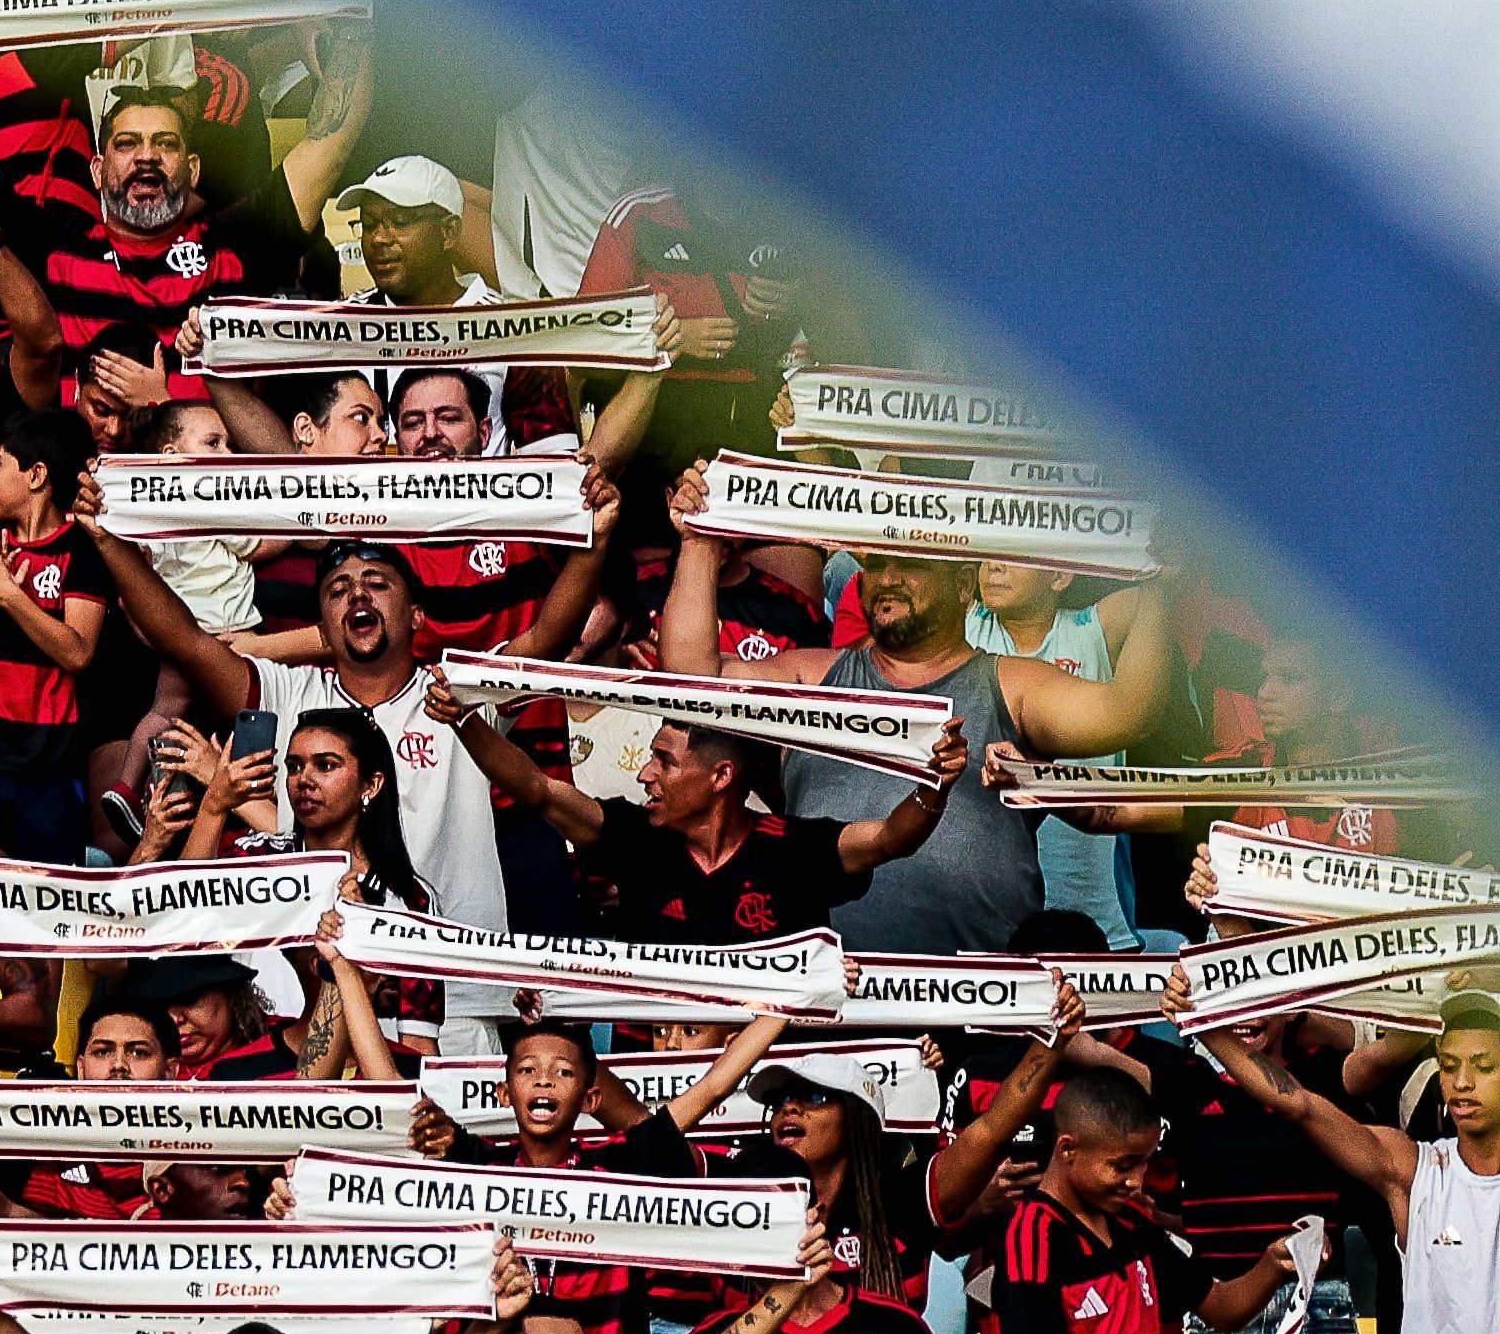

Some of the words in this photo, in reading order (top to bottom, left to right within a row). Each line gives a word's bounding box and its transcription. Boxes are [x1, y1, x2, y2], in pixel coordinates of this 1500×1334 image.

[727, 475, 778, 506] PRA
[788, 483, 862, 513] CIMA
[871, 491, 955, 524] DELES,
[325, 513, 387, 525] Betano
[909, 530, 969, 546] Betano
[10, 1105, 92, 1126] CIMA
[99, 1105, 192, 1132] DELES,
[200, 1106, 383, 1130] FLAMENGO!
[328, 1173, 384, 1204] PRA
[395, 1179, 474, 1211] CIMA
[485, 1186, 575, 1224] DELES,
[587, 1193, 770, 1230] FLAMENGO!
[530, 1227, 595, 1243] Betano
[13, 1243, 68, 1270] PRA
[79, 1243, 159, 1270] CIMA
[170, 1244, 261, 1272] DELES,
[273, 1244, 456, 1270] FLAMENGO!
[216, 1283, 279, 1296] Betano
